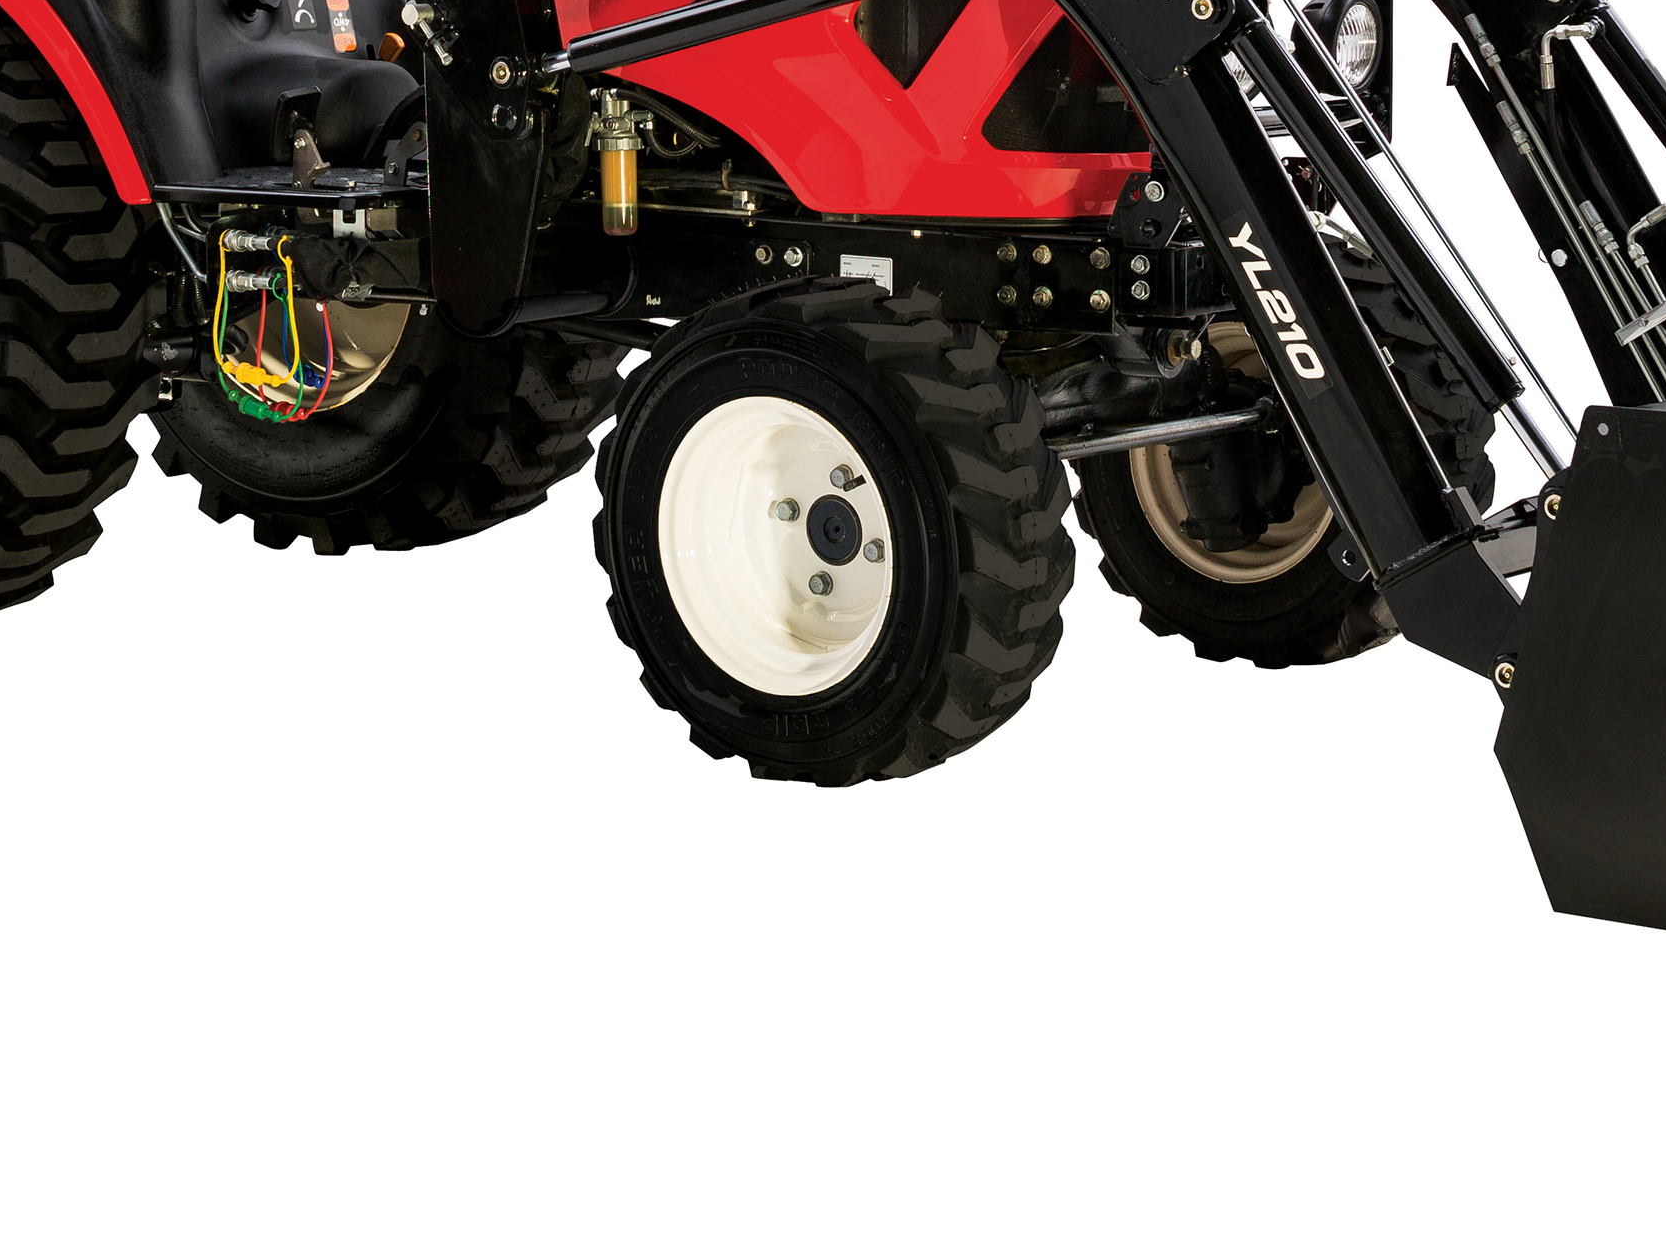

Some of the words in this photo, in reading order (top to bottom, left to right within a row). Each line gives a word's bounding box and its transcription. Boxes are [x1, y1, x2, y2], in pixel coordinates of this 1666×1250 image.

[333, 17, 350, 27] 4WD
[1228, 221, 1325, 379] YL210
[738, 358, 839, 408] POWER
[762, 709, 830, 735] GRIP
